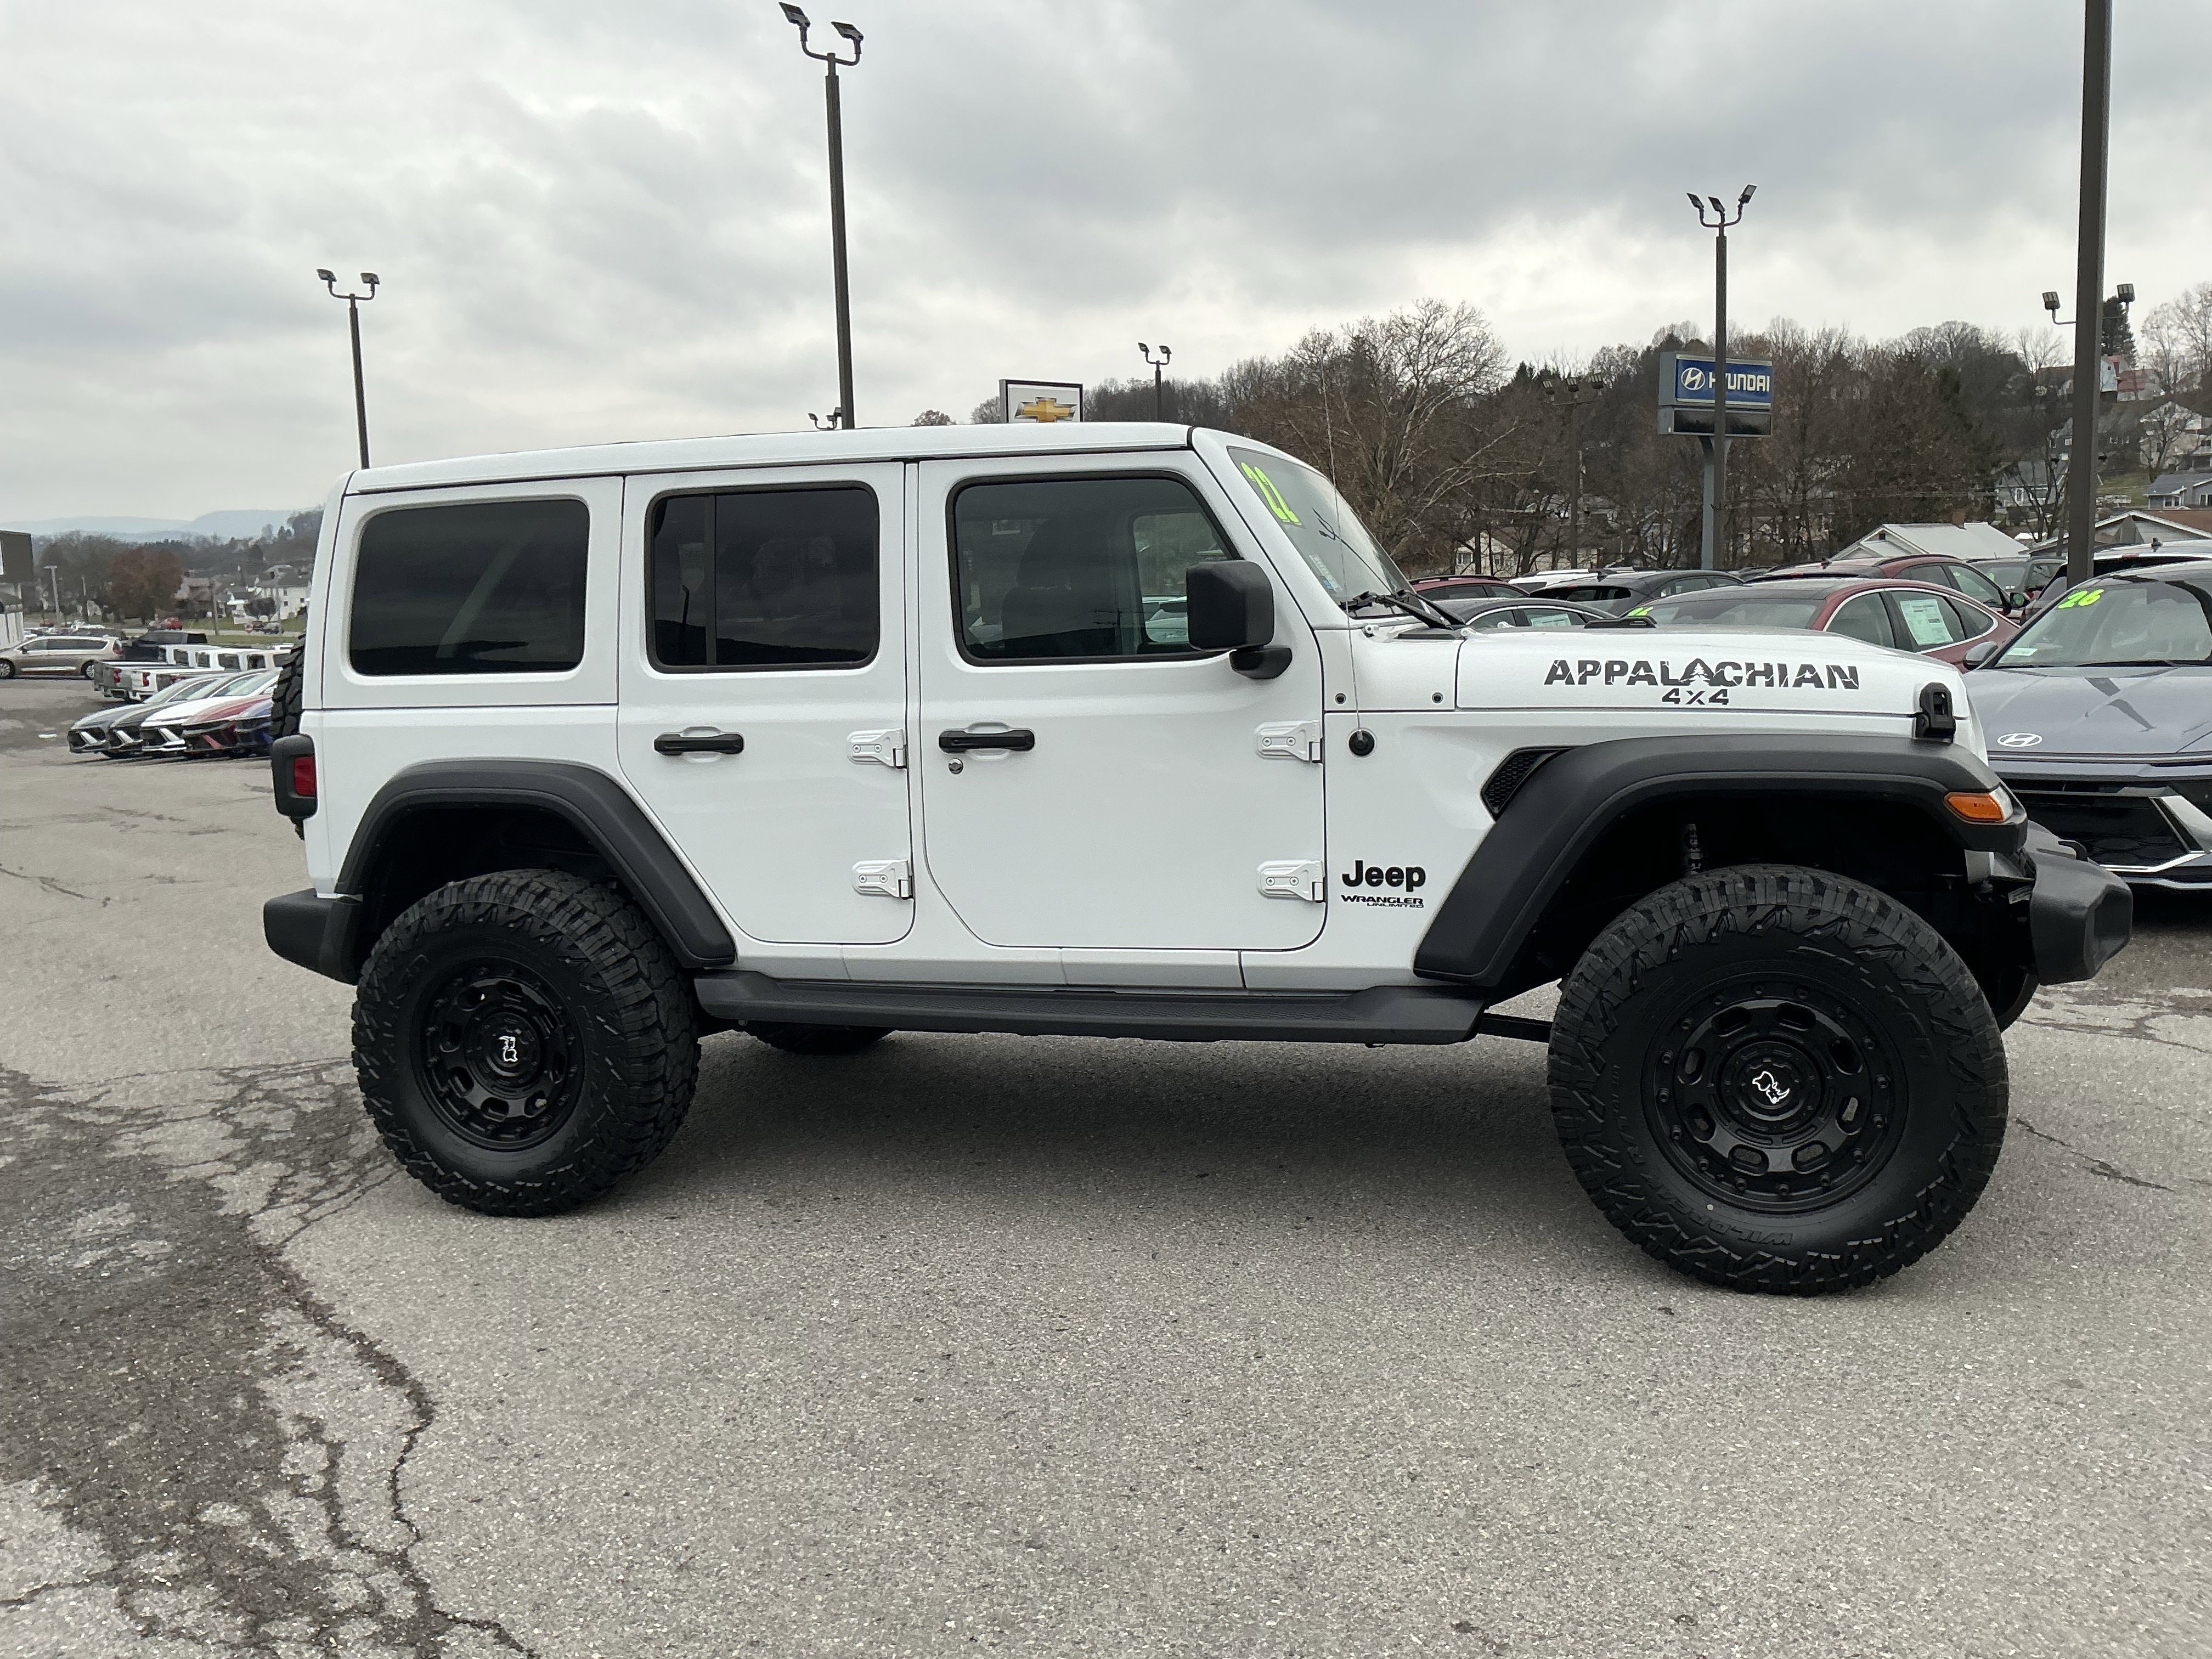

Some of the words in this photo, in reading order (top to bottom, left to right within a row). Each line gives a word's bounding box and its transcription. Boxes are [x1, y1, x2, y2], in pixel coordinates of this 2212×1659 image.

[1708, 371, 1770, 392] HUNDAI
[1240, 462, 1302, 526] 22
[2058, 589, 2104, 609] 26
[1543, 658, 1860, 690] APPALACHIAN
[1341, 860, 1426, 893] Jeep
[1340, 895, 1424, 905] WRANGLER
